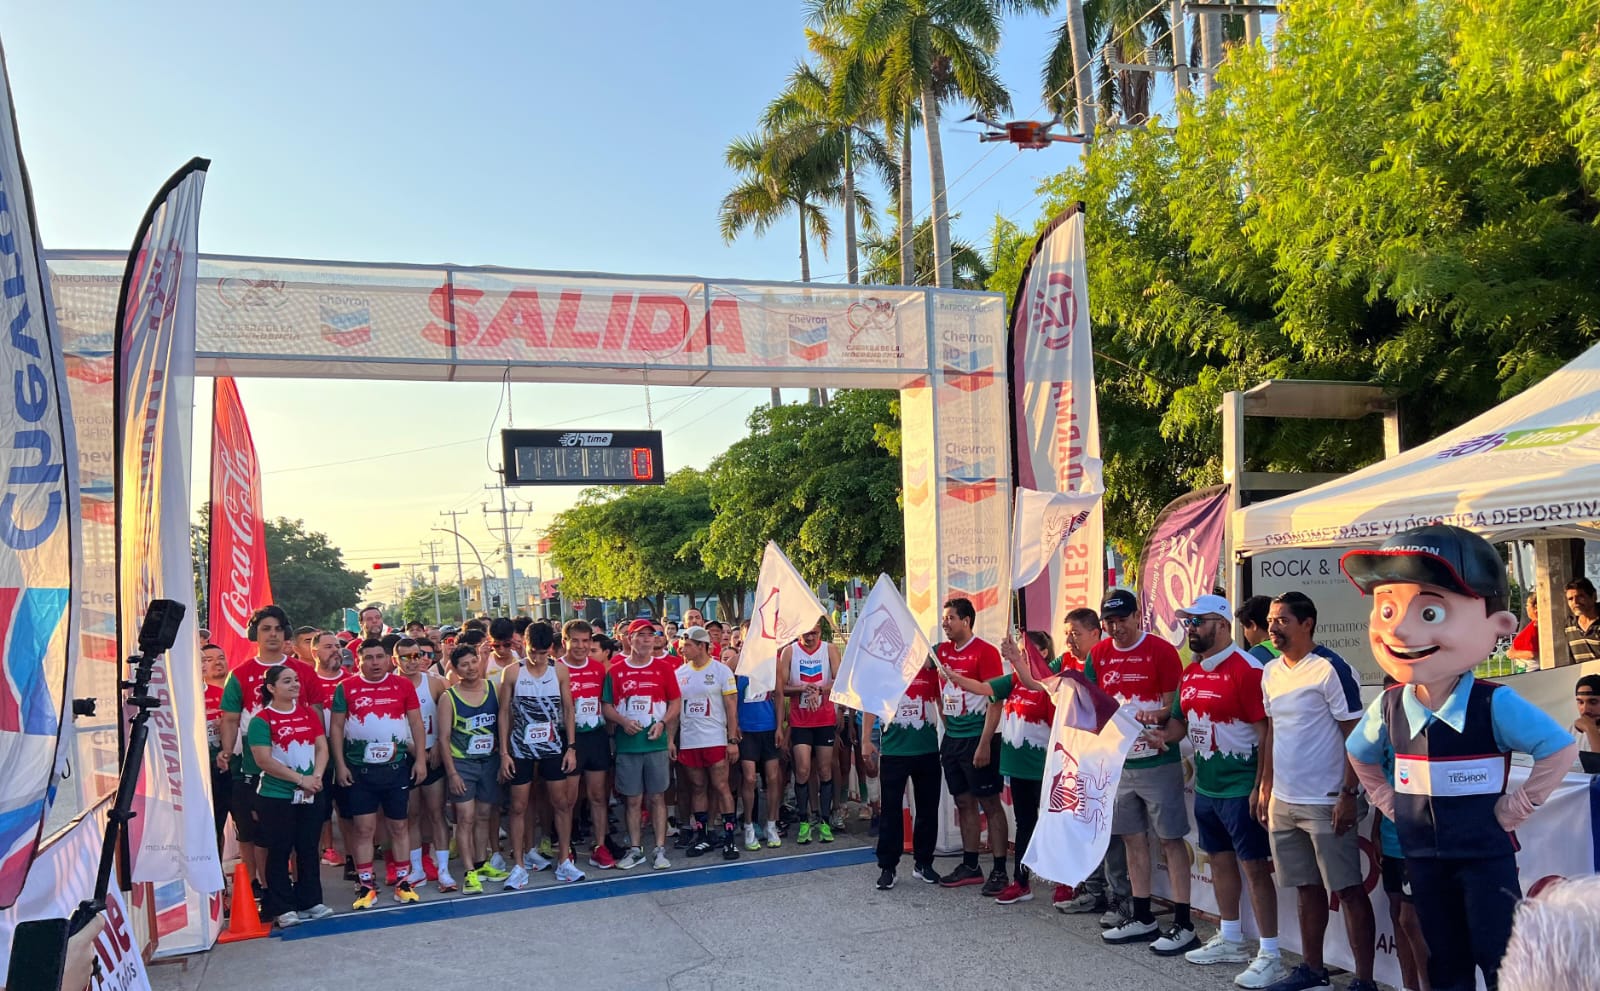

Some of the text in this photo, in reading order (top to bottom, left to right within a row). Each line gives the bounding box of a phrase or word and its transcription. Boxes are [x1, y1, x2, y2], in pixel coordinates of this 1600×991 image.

[421, 283, 746, 353] SALIDA
[943, 330, 993, 344] Chevron
[587, 434, 609, 444] time
[945, 442, 996, 455] Chevron
[632, 447, 654, 480] 0
[1383, 519, 1393, 536] Y
[1492, 500, 1600, 525] DEPORTIV
[220, 439, 254, 639] Coca-Cola
[947, 553, 998, 565] Chevron
[1261, 558, 1330, 578] ROCK &
[1316, 621, 1369, 634] ormamos
[1319, 636, 1360, 649] spacios
[902, 709, 919, 717] 234
[371, 751, 388, 759] 162
[1448, 773, 1487, 784] TECHRON
